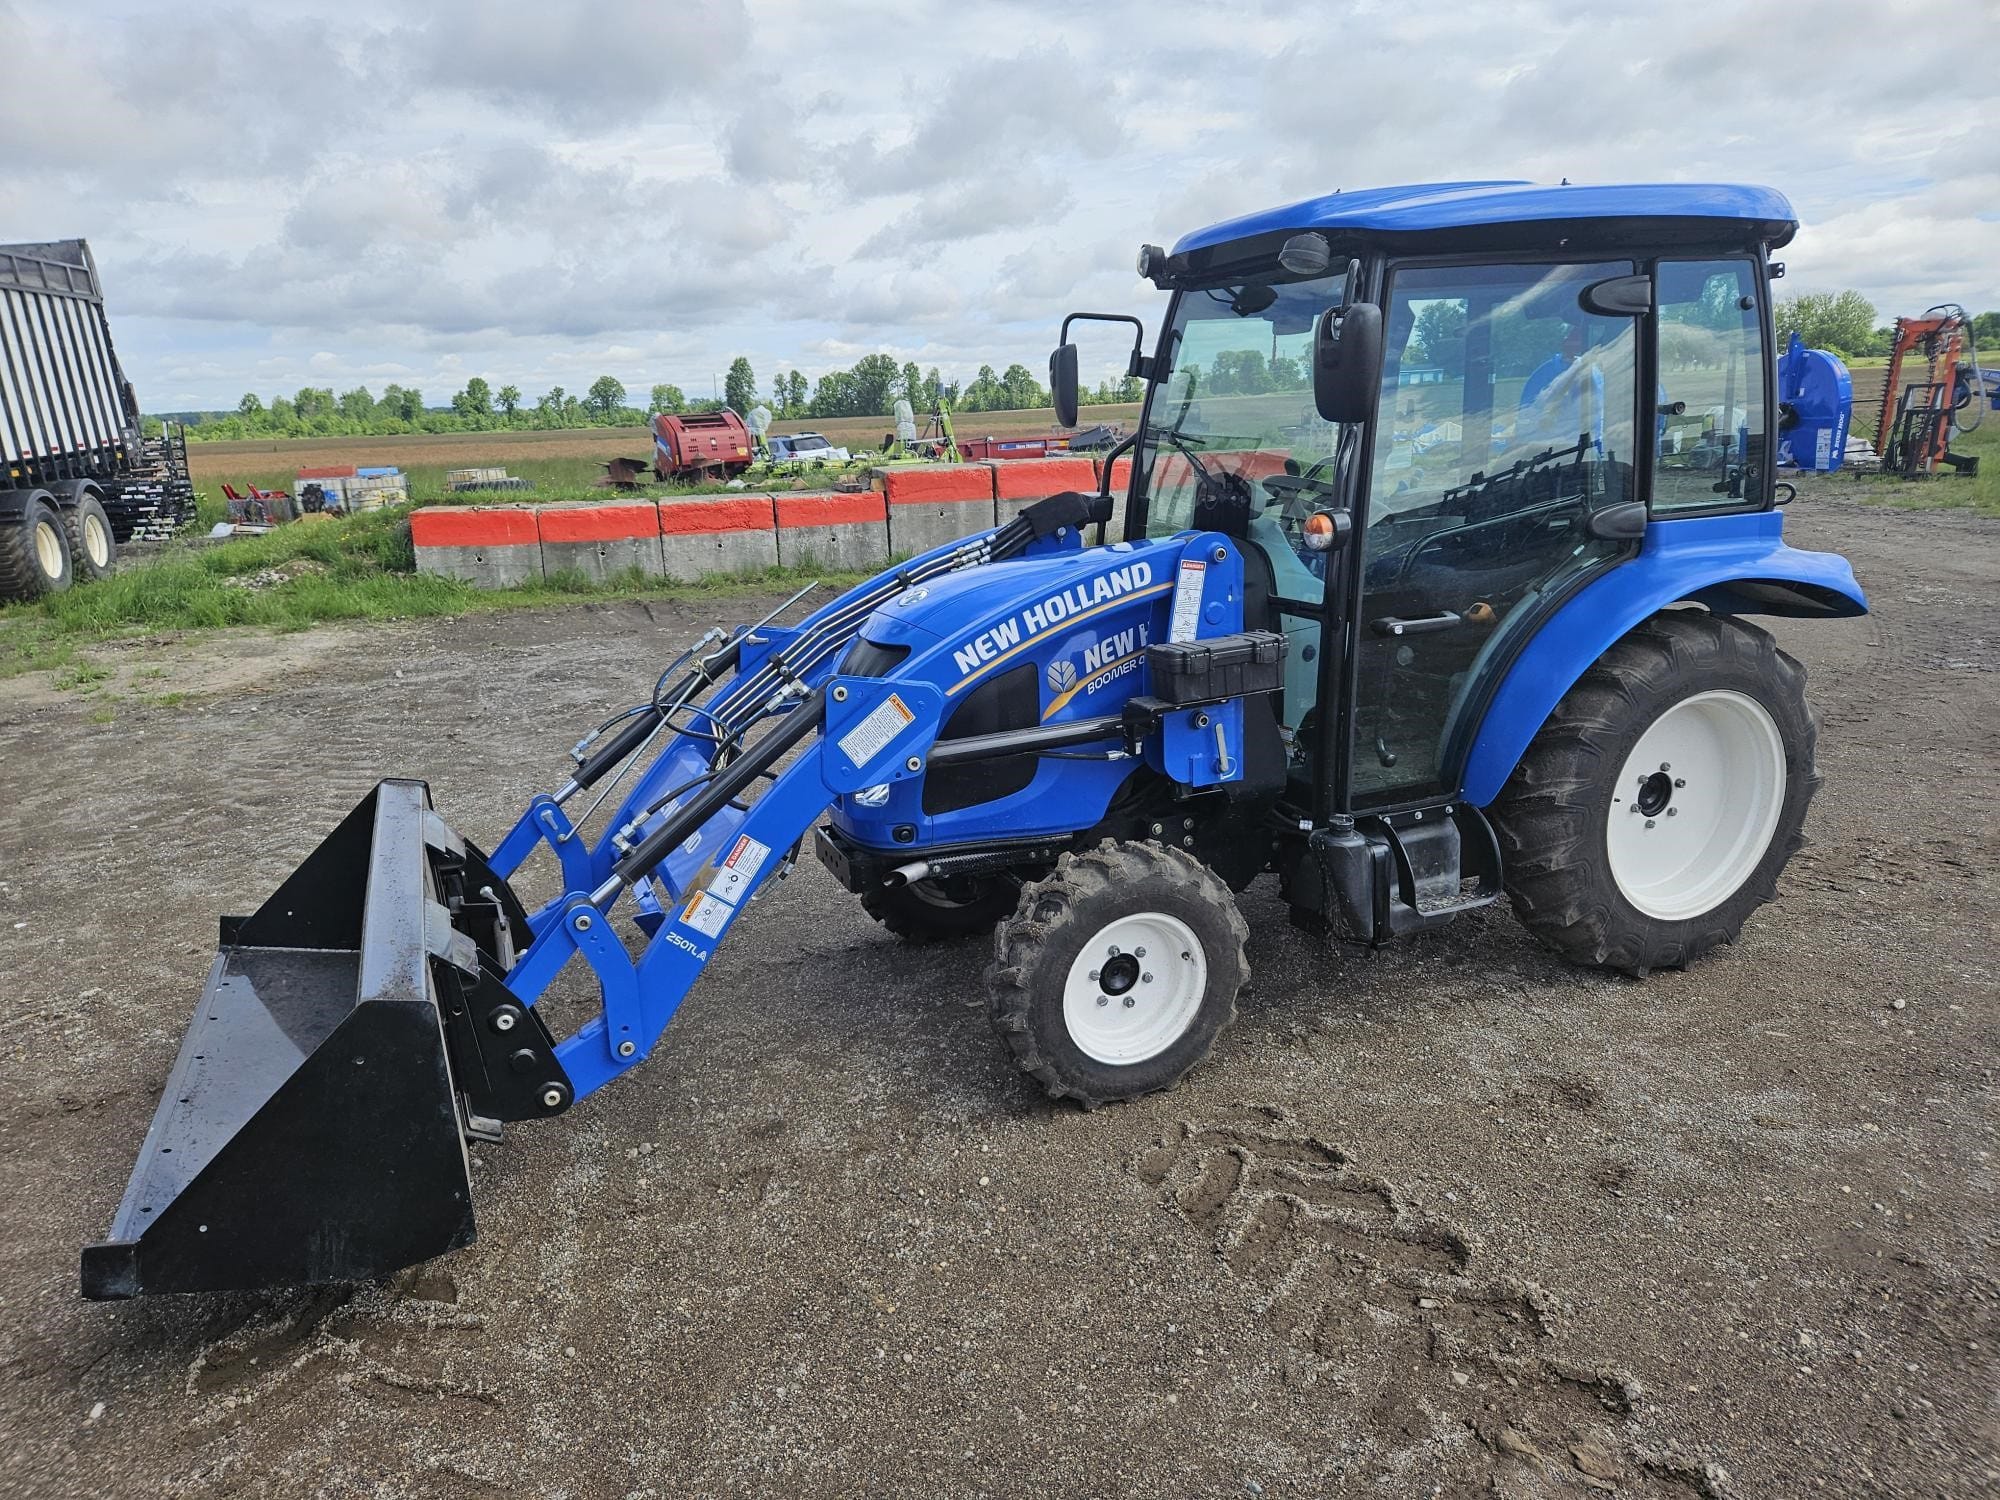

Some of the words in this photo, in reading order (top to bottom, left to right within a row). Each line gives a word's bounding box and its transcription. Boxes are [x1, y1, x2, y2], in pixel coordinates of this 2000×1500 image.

[953, 618, 1020, 675] NEW
[1022, 562, 1152, 635] HOLLAND
[1084, 627, 1134, 674] NEW
[1087, 659, 1137, 695] BOOMER
[732, 837, 750, 861] DANGER
[665, 931, 707, 962] 250TLA
